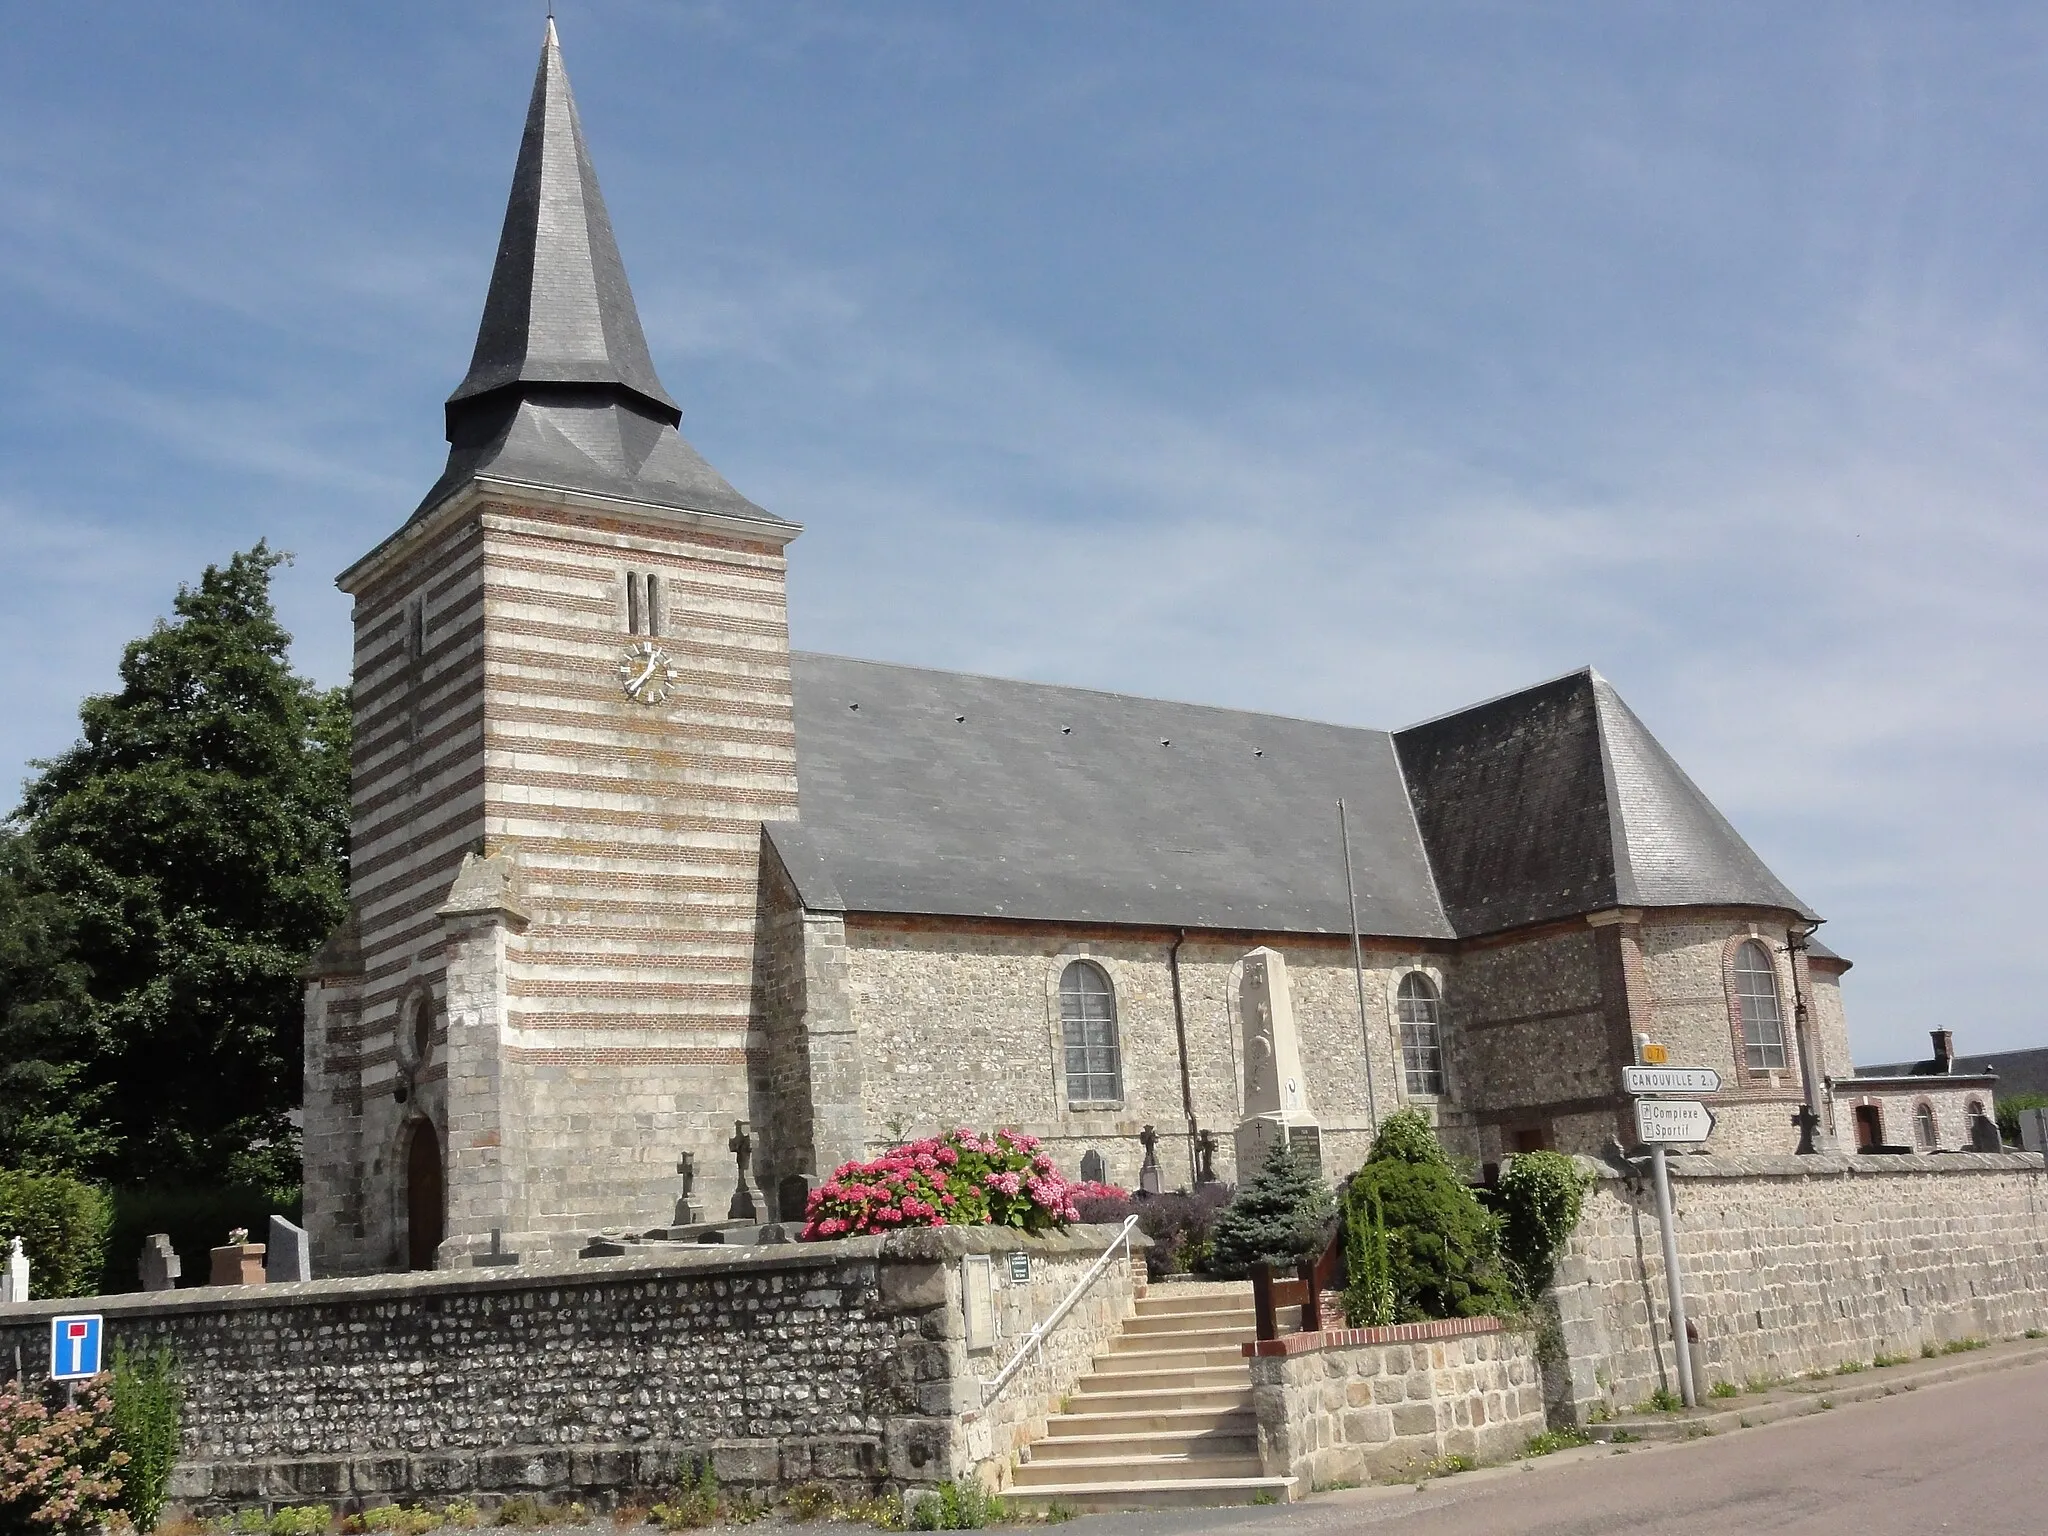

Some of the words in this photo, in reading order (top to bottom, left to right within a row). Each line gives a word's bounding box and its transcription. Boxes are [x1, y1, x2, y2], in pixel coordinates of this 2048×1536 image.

[1632, 1074, 1693, 1086] CANOUVILLE
[1653, 1106, 1698, 1121] Complexe
[1655, 1124, 1690, 1138] Sportif
